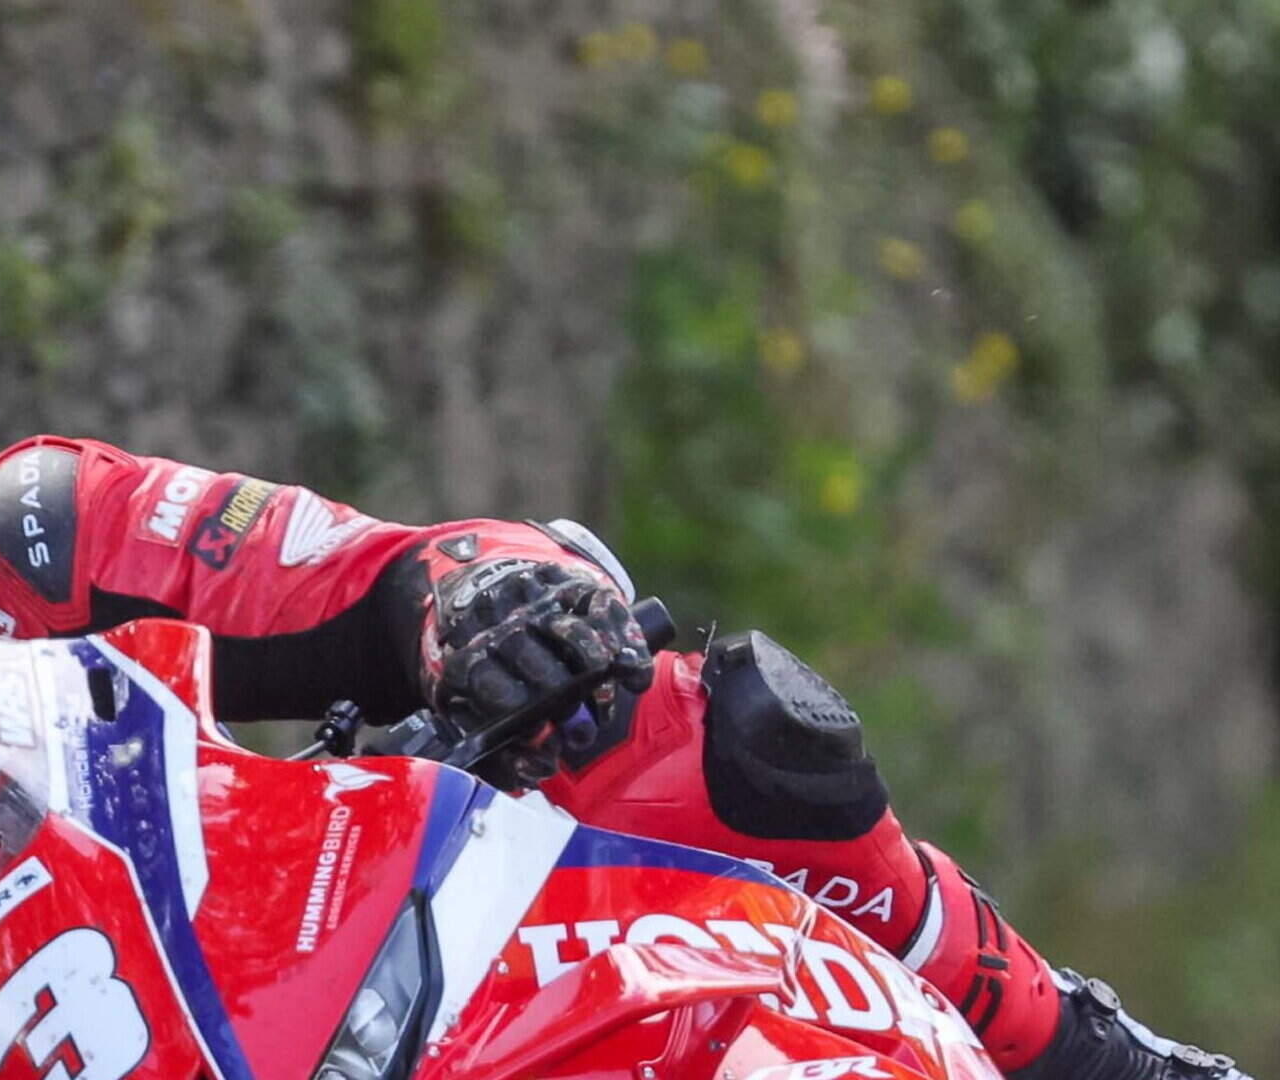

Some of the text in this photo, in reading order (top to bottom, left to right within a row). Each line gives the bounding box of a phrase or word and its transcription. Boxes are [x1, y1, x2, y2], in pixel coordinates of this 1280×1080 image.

[20, 451, 50, 568] SPADA
[149, 466, 218, 541] MOT
[296, 806, 352, 953] HUMMINGBIRD
[746, 857, 895, 923] ADA
